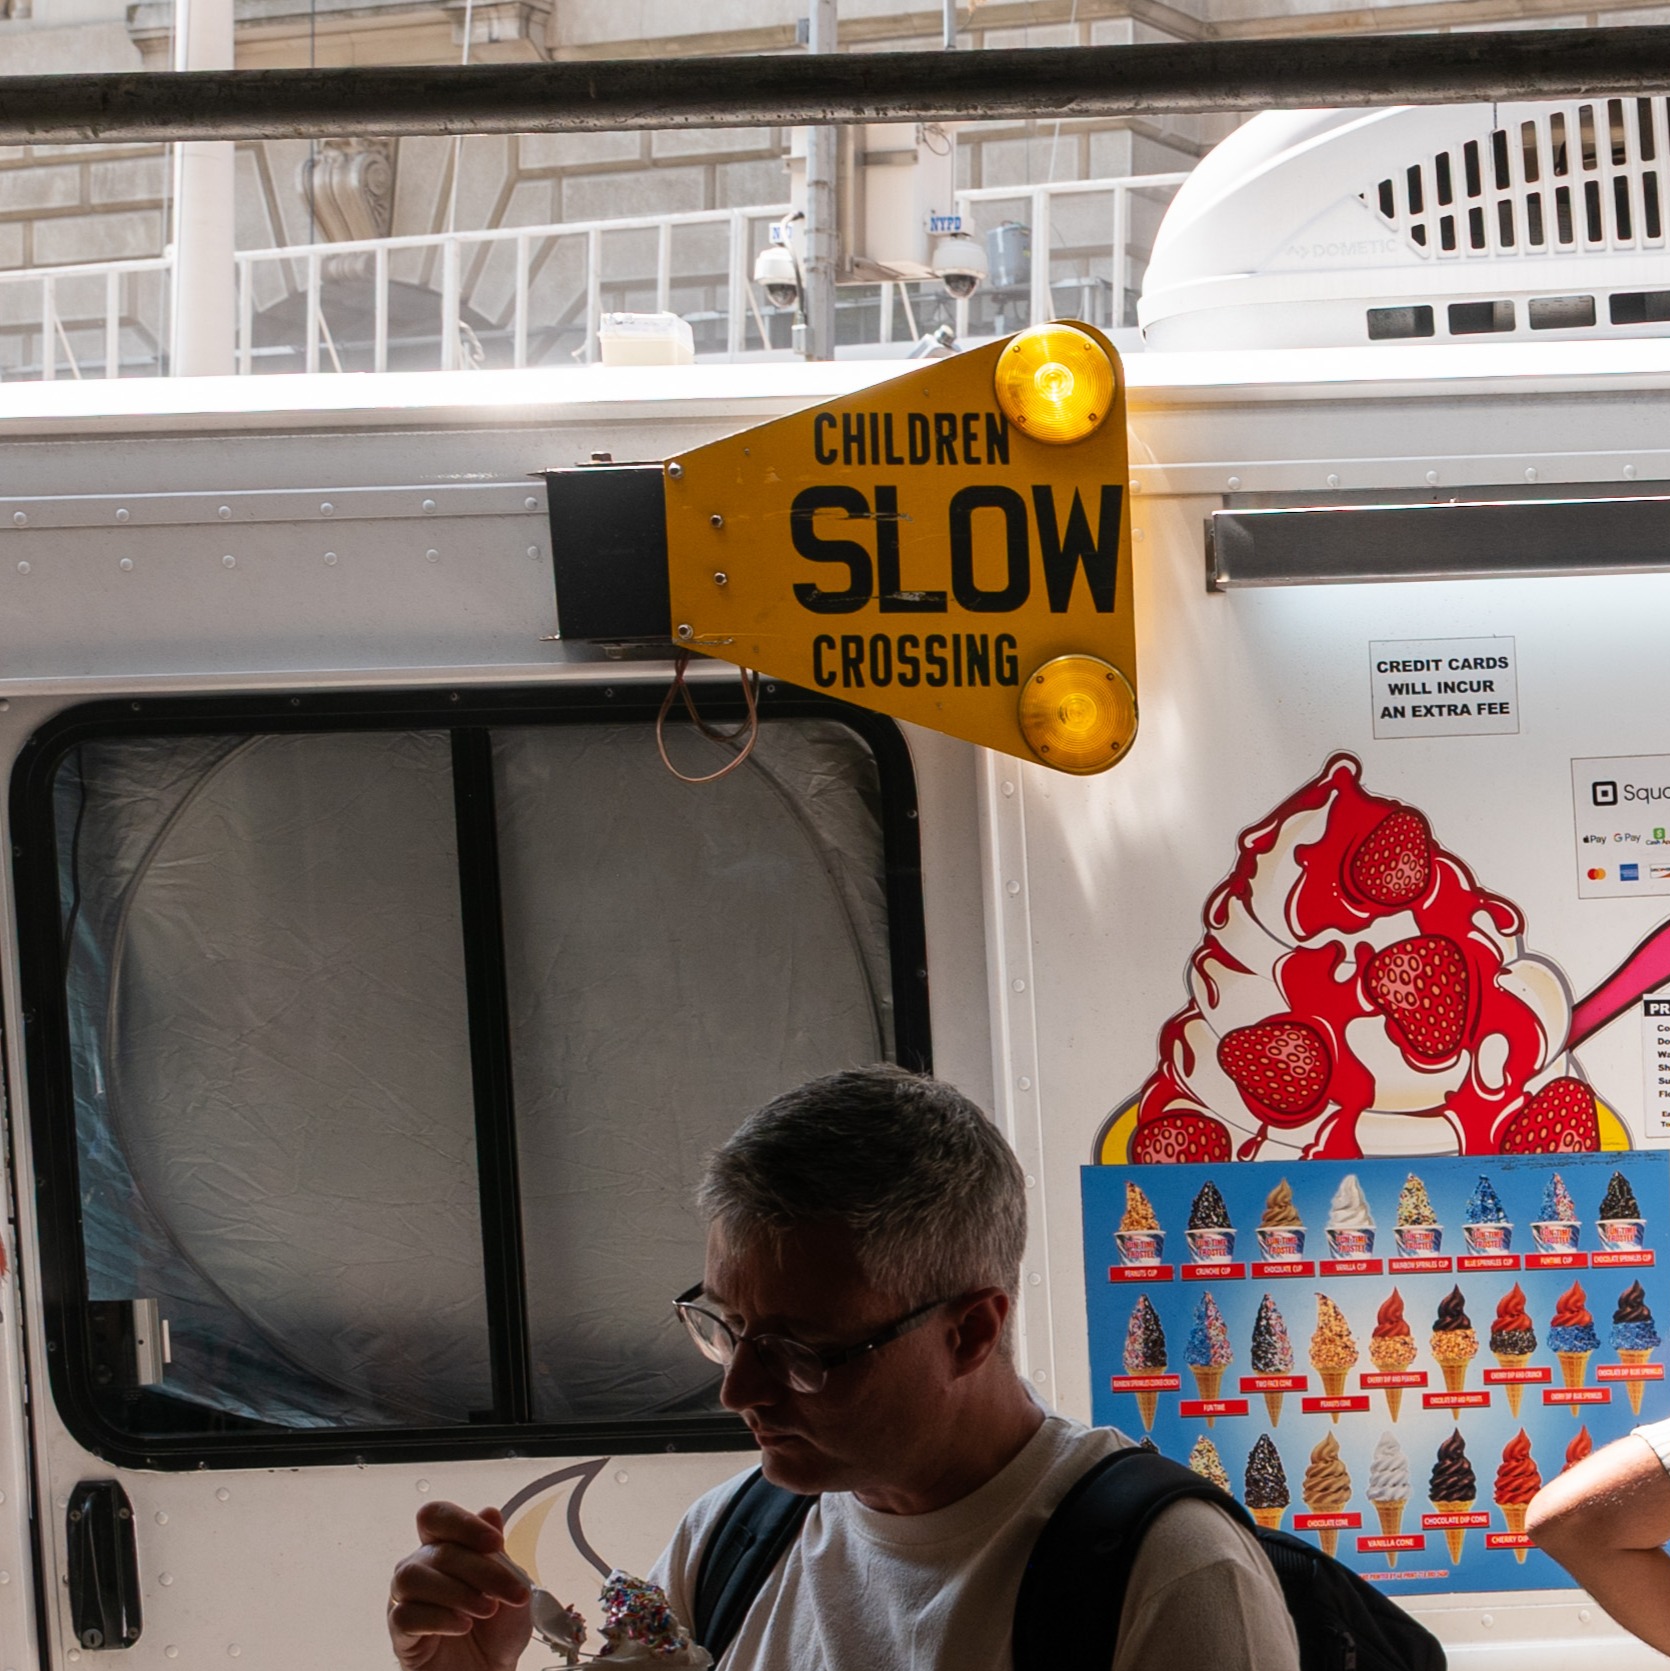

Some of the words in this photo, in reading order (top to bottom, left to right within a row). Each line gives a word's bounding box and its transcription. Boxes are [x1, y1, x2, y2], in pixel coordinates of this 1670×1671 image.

[930, 216, 961, 231] NYPD
[1313, 239, 1396, 257] DOMETIC
[814, 411, 1010, 466] CHILDREN
[790, 484, 1123, 615] SLOW
[812, 633, 1019, 688] CROSSING
[1377, 659, 1442, 673] CREDIT
[1448, 656, 1509, 671] CARDS
[1388, 682, 1432, 695] WILL
[1437, 680, 1495, 694] INCUR
[1381, 706, 1405, 719] AN
[1412, 703, 1471, 718] EXTRA
[1477, 702, 1510, 715] FEE
[1590, 835, 1607, 845] Pay
[1307, 1519, 1334, 1527] CHOCOLATE
[1424, 1517, 1459, 1525] CHOCOLATE
[1367, 1539, 1395, 1547] VANILLA
[1396, 1538, 1414, 1546] CONE
[1491, 1536, 1517, 1544] CHERRY
[1518, 1535, 1529, 1543] DIP
